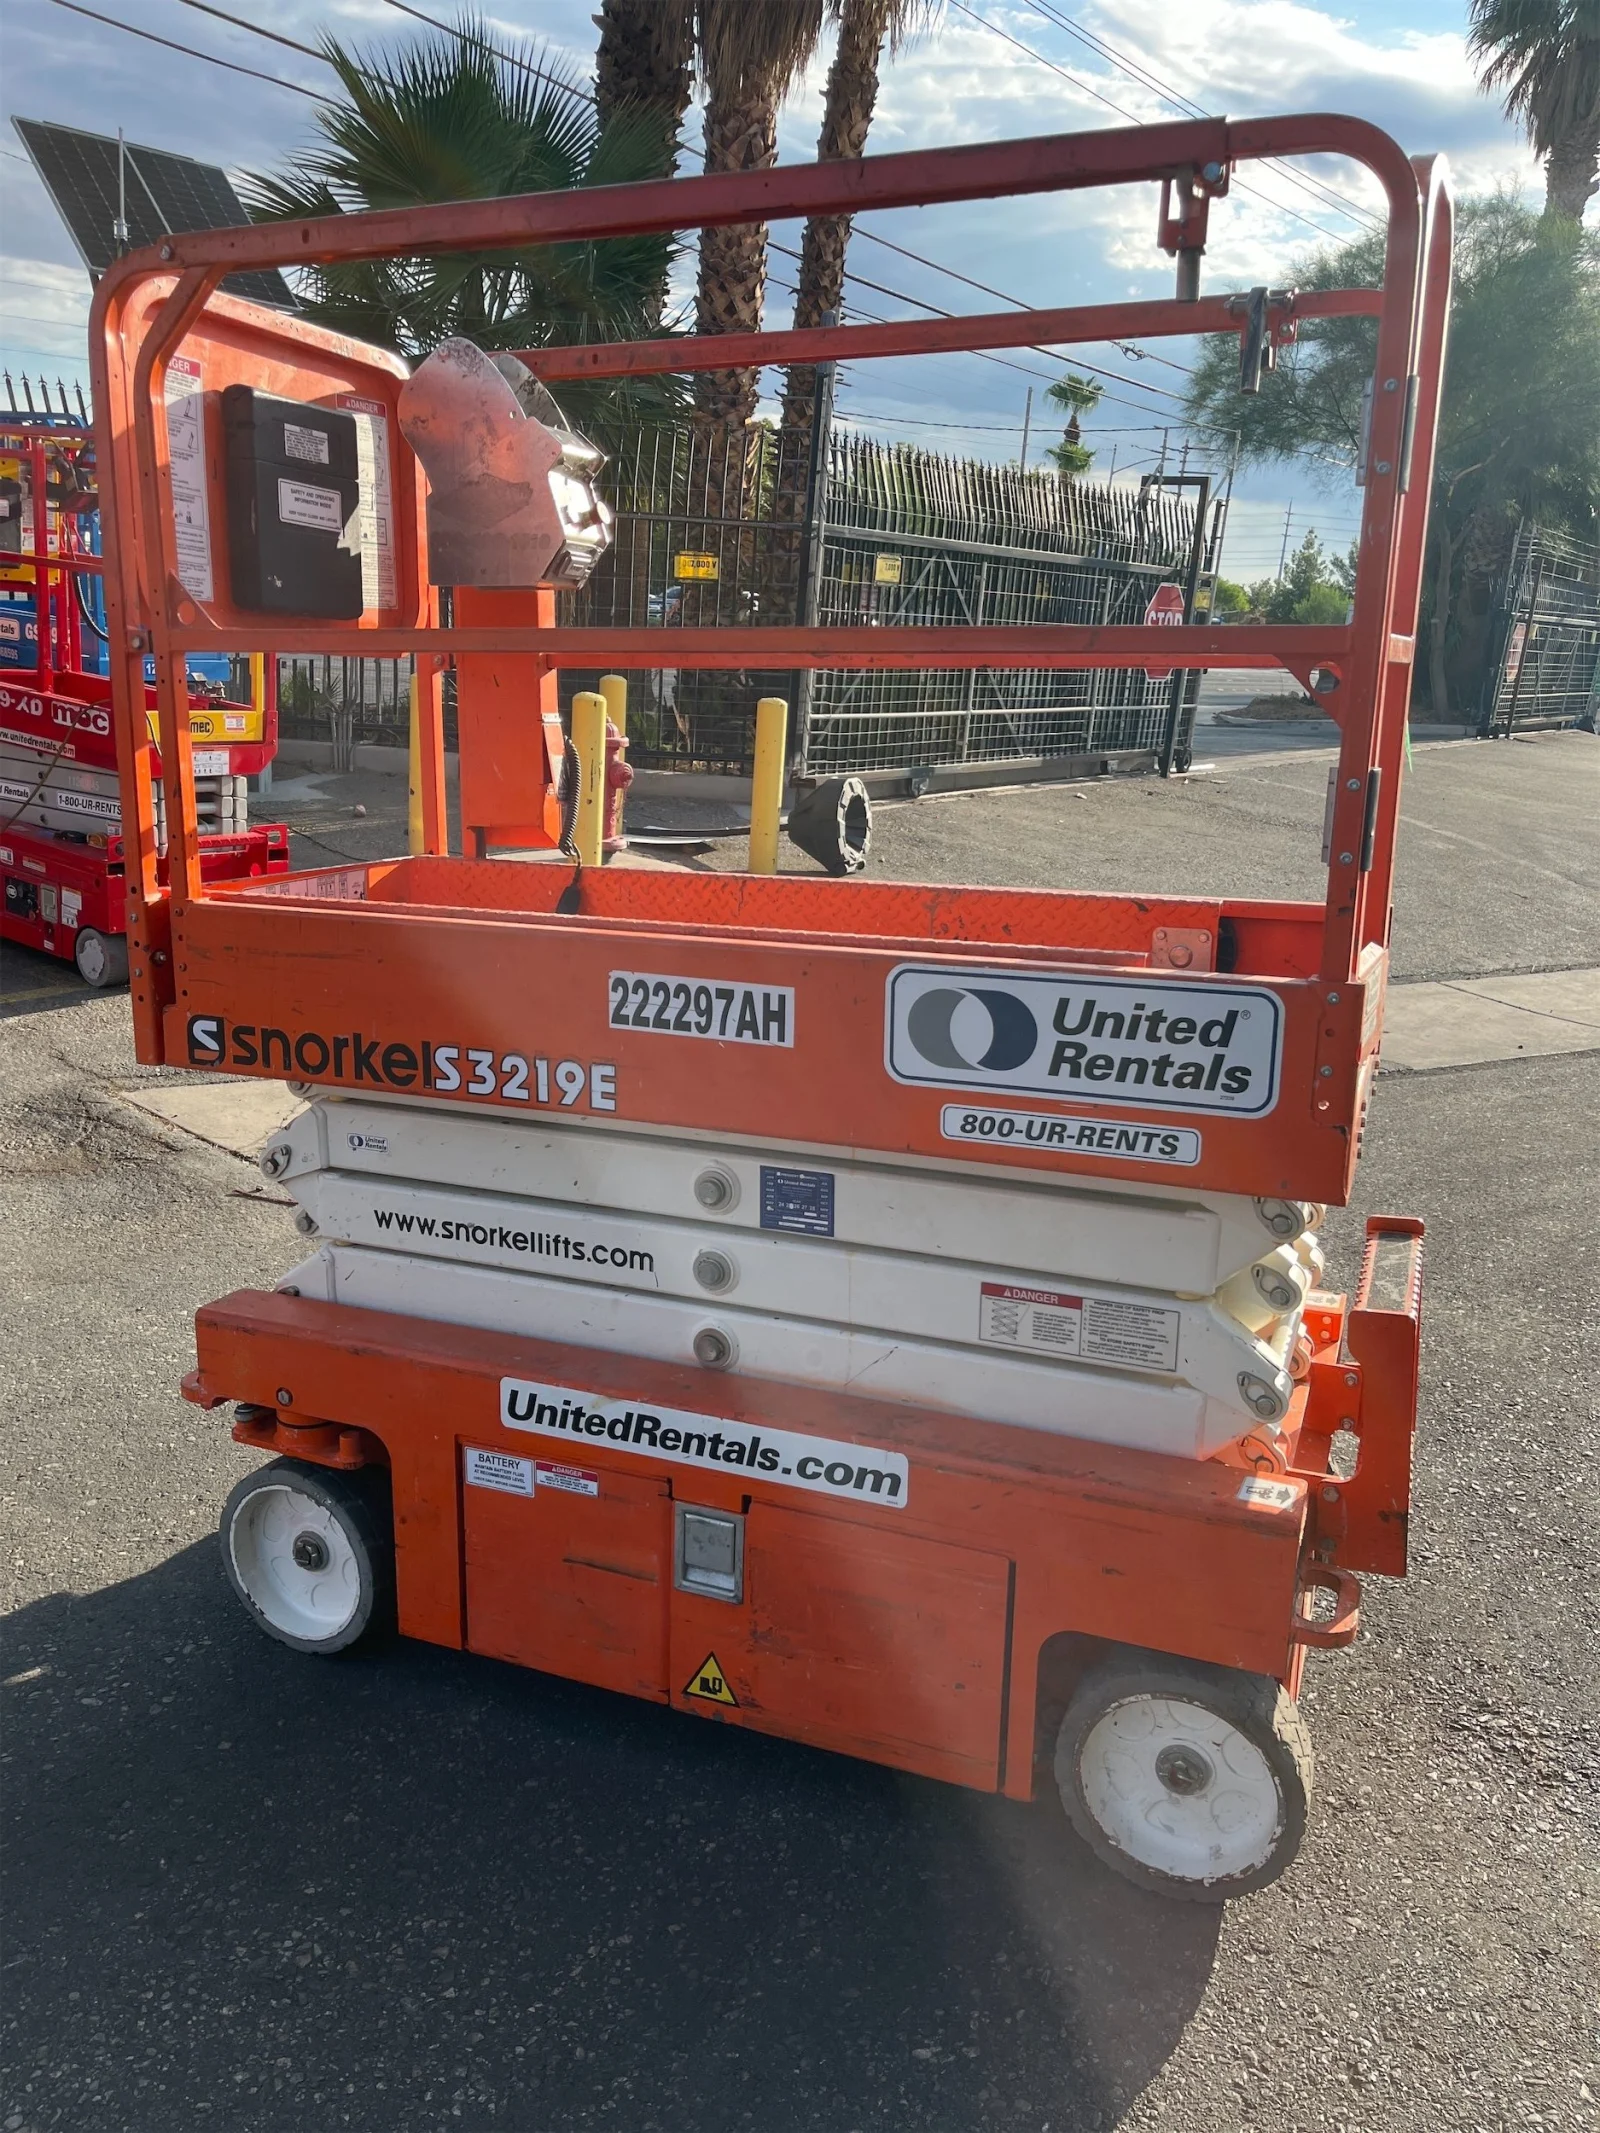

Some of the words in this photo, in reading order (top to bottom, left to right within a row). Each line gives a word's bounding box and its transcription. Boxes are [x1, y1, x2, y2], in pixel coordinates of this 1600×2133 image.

[350, 401, 378, 413] DANGER
[190, 722, 210, 733] mec
[4, 786, 29, 798] Rentals
[58, 795, 121, 815] 1-800-UR-RENTS
[611, 977, 786, 1042] 222297AH
[232, 1025, 432, 1089] snorkel
[434, 1045, 617, 1112] S3219E
[1048, 1041, 1252, 1094] Rentals
[365, 1136, 386, 1144] United
[960, 1114, 1180, 1156] 800-UR-RENTS
[365, 1142, 387, 1151] Rentals
[373, 1209, 655, 1272] www.snorkellifts.com
[1012, 1289, 1059, 1305] DANGER
[507, 1389, 902, 1497] UnitedRentals.com
[478, 1453, 520, 1470] BATTERY
[494, 1468, 512, 1476] BATTERY
[556, 1466, 583, 1478] DANGER
